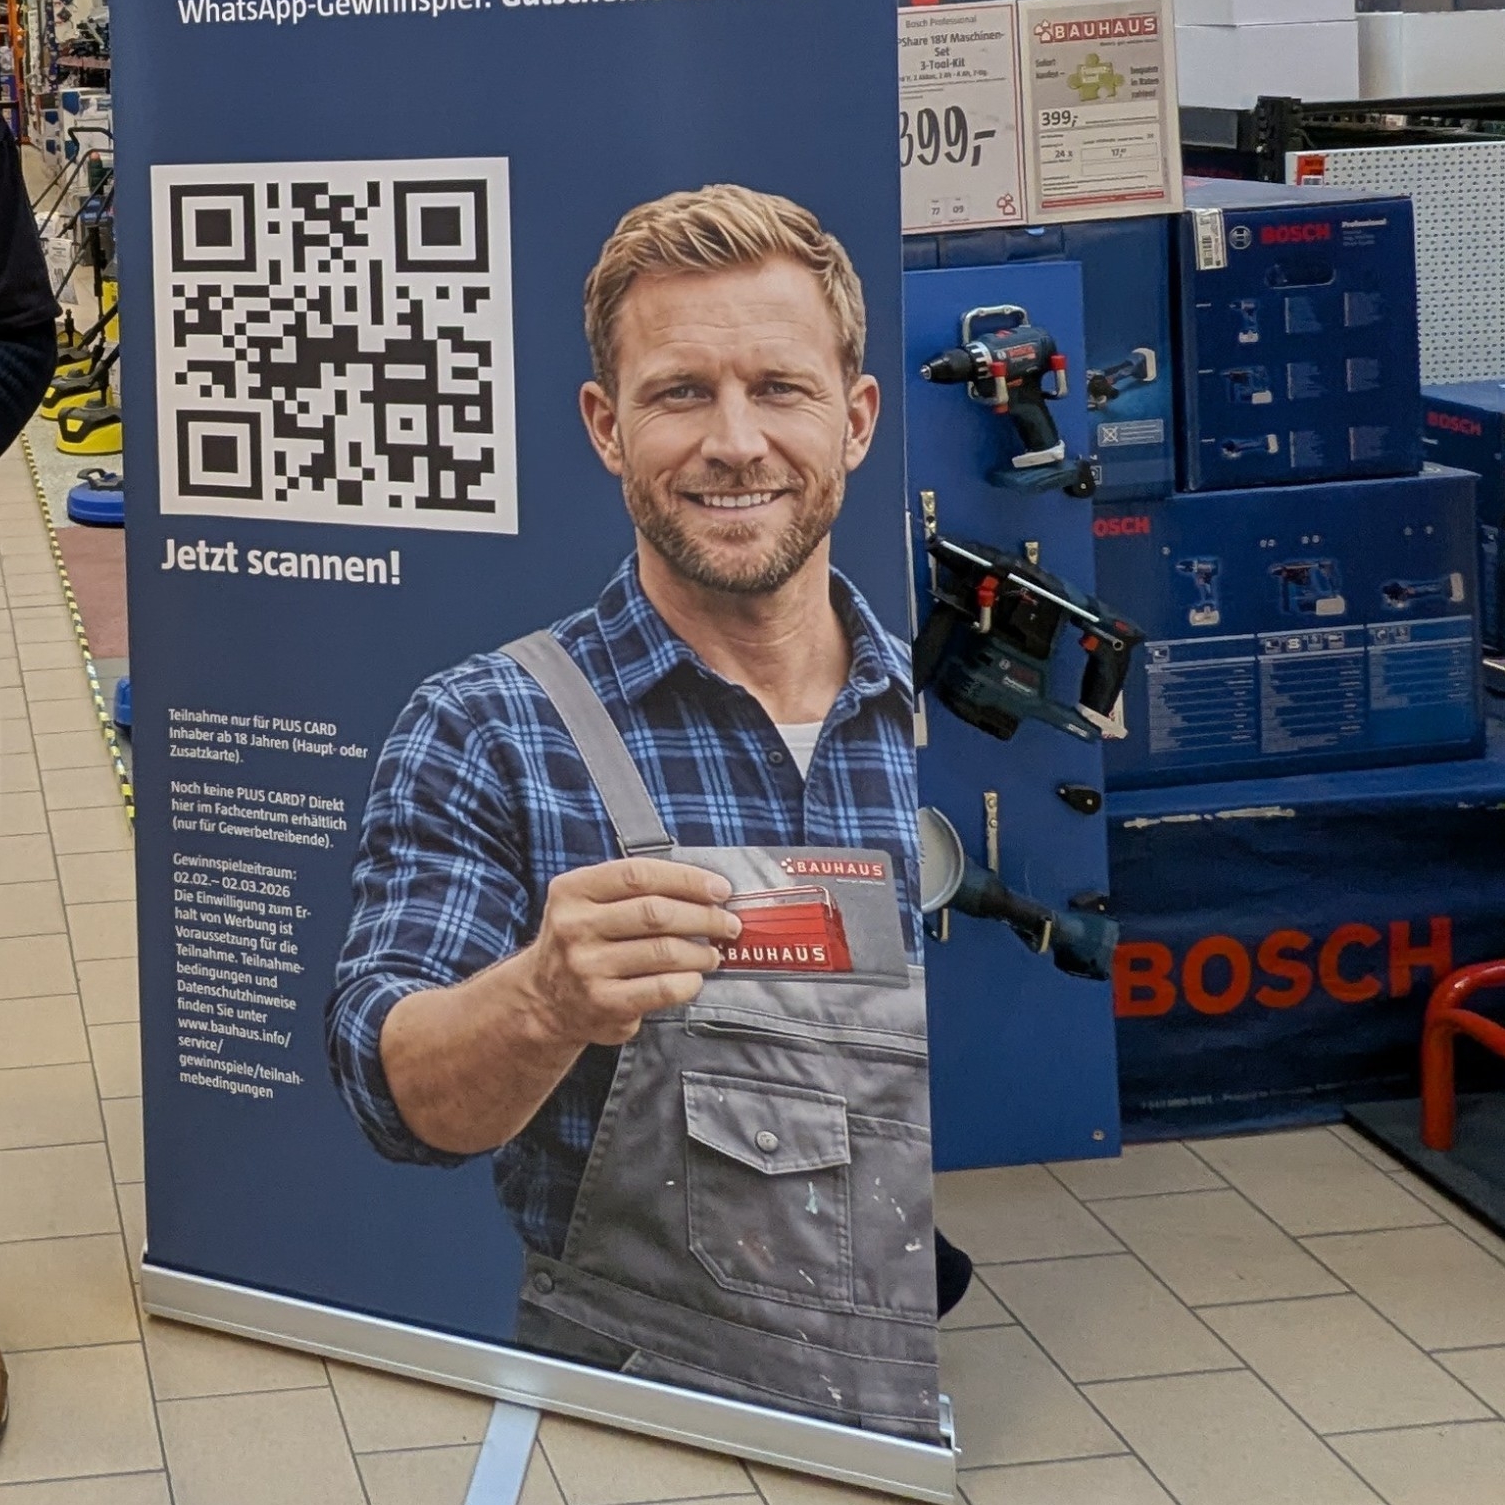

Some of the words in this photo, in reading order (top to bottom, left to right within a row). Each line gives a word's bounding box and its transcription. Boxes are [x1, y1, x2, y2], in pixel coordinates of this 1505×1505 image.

[905, 19, 928, 29] Bosch
[1054, 17, 1156, 39] BAUHAUS
[931, 33, 949, 45] 18V
[950, 30, 1005, 44] Maschinen-
[934, 46, 951, 57] Set
[920, 57, 966, 71] 3-Tool-Kit
[1041, 110, 1079, 127] 399,-
[899, 105, 997, 168] 399,-
[1261, 222, 1332, 245] BOSCH
[1427, 410, 1483, 437] BOSCH
[1093, 515, 1151, 539] OSCH
[161, 538, 240, 573] Jetzt
[247, 549, 401, 585] scannen!
[168, 708, 228, 725] Teilnahme
[231, 716, 251, 727] nur
[253, 715, 270, 729] für
[273, 717, 302, 733] PLUS
[304, 721, 337, 737] CARD
[169, 727, 214, 741] Inhaber
[217, 730, 232, 743] ab
[234, 732, 248, 745] 18
[250, 734, 289, 750] Jahren
[339, 744, 368, 758] oder
[170, 744, 243, 764] Zusatzkarte).
[171, 781, 201, 794] Noch
[204, 783, 234, 798] keine
[237, 787, 265, 802] PLUS
[268, 791, 306, 807] CARD?
[309, 795, 344, 812] Direkt
[171, 798, 194, 812] hier
[197, 803, 212, 814] im
[215, 802, 288, 824] Fachcentrum
[291, 813, 347, 831] erhältlich
[173, 816, 197, 830] (nur
[199, 818, 216, 832] für
[797, 860, 883, 878] BAUHAUS
[222, 876, 290, 898] 02.03.2026
[174, 889, 194, 902] Die
[196, 891, 265, 916] Einwilligung
[268, 903, 293, 917] zum
[175, 906, 198, 921] halt
[200, 912, 221, 924] von
[223, 913, 276, 936] Werbung
[279, 921, 293, 936] ist
[175, 925, 257, 951] Voraussetzung
[260, 936, 277, 951] für
[280, 940, 298, 955] die
[176, 943, 238, 963] Teilnahme.
[727, 945, 826, 963] BAUHAUS
[177, 961, 252, 984] bedingungen
[255, 975, 277, 988] und
[1112, 915, 1453, 1019] BOSCH
[177, 997, 214, 1014] finden
[217, 1003, 234, 1018] Sie
[237, 1009, 268, 1023] unter
[178, 1036, 223, 1055] service/
[180, 1072, 273, 1099] mebedingungen
